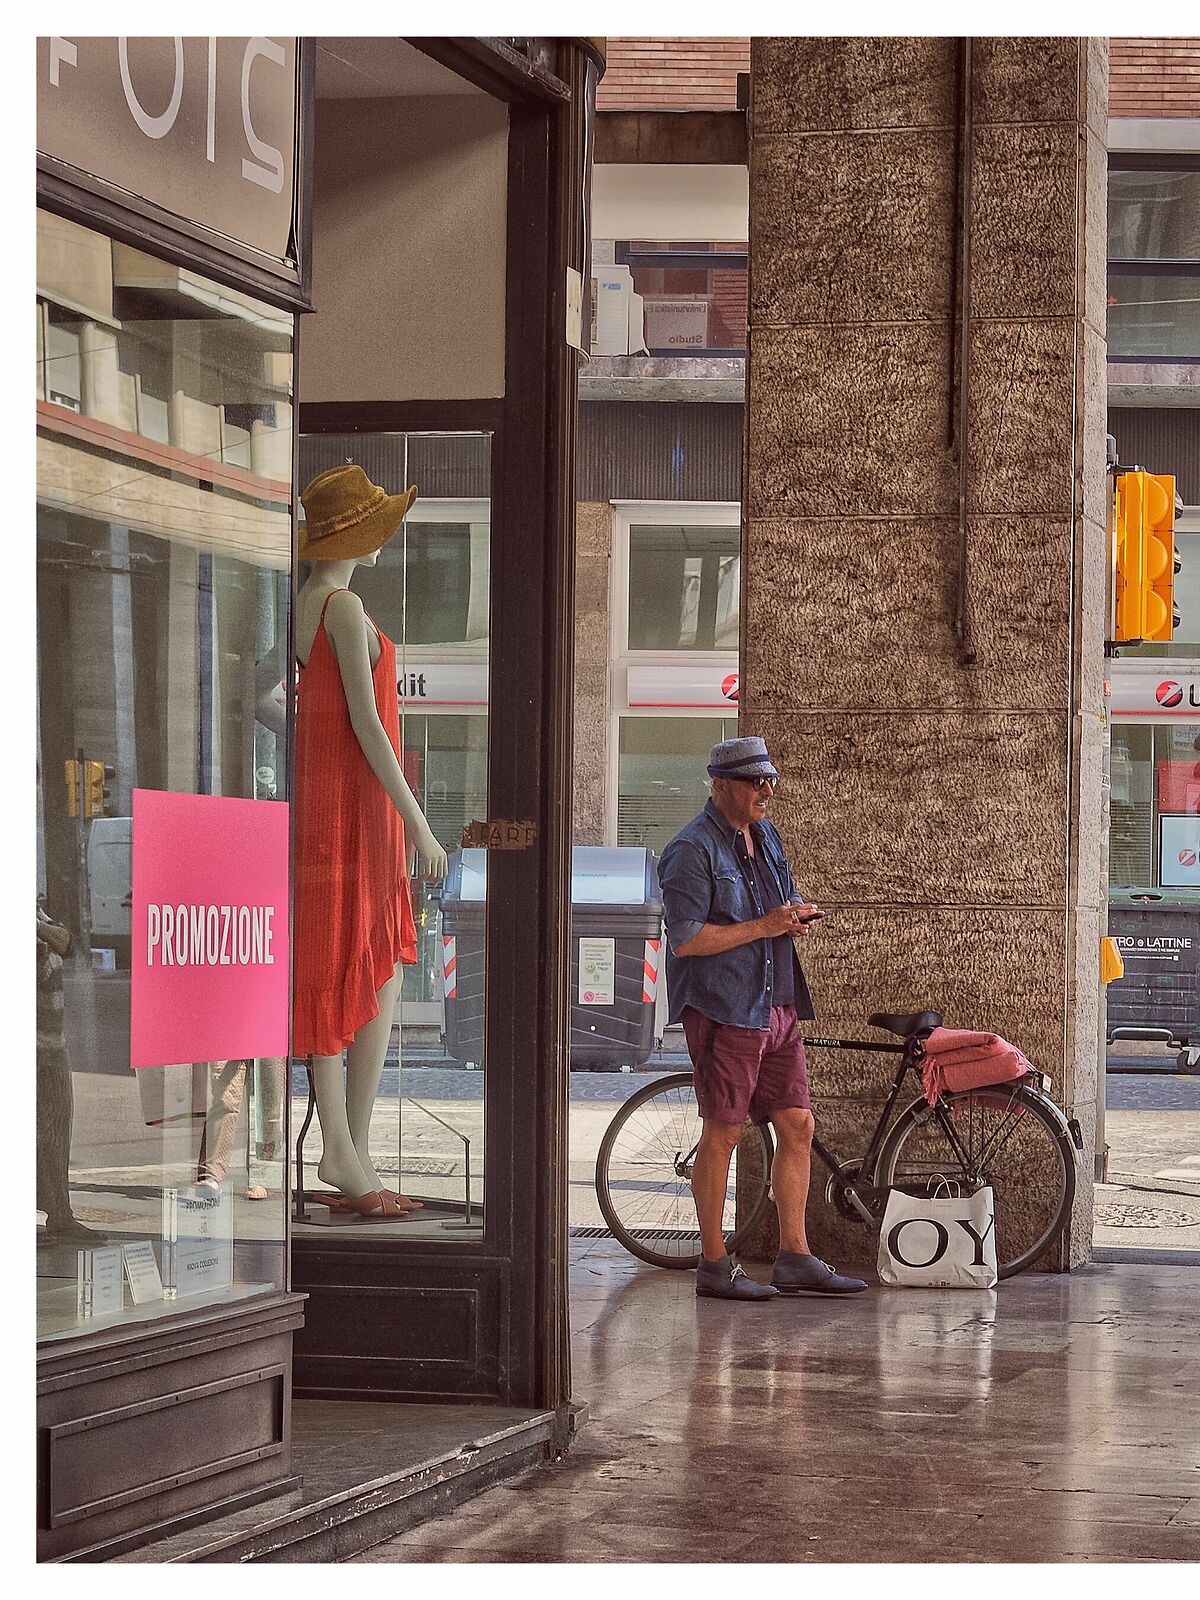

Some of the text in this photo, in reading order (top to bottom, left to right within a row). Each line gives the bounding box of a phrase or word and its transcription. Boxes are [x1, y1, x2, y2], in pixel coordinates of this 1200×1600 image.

[147, 904, 275, 966] PROMOZIONE
[1146, 937, 1192, 948] LATTINE
[887, 1213, 995, 1268] OY
